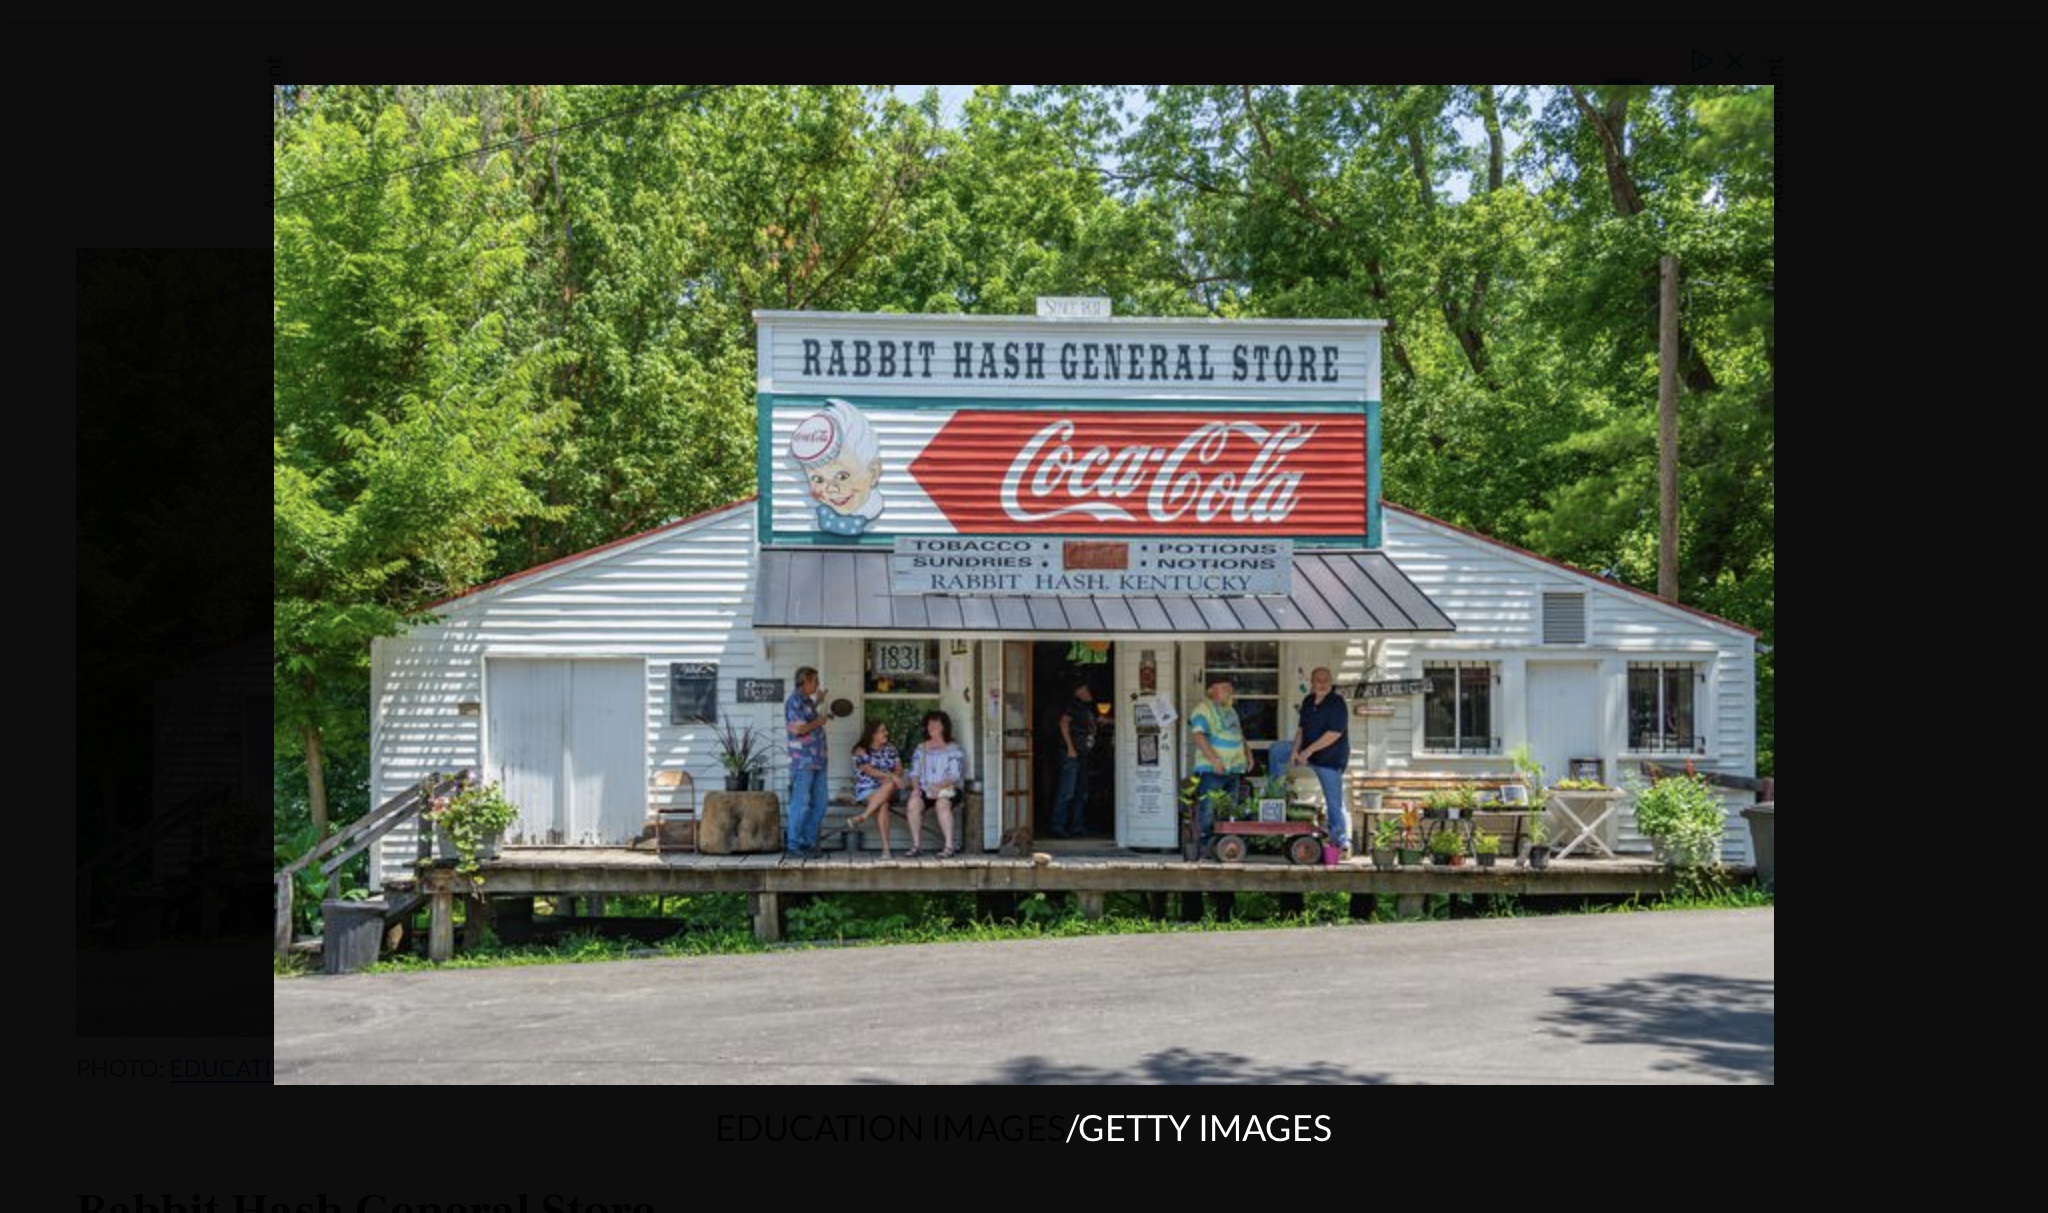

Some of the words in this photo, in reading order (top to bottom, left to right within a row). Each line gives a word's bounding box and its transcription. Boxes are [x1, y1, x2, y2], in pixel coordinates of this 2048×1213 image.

[802, 338, 935, 378] RABBIT
[953, 341, 1046, 380] HASH
[1060, 342, 1215, 380] GENERAL
[1232, 344, 1339, 383] STORE
[1000, 418, 1320, 523] Coca-Cola
[912, 540, 1032, 552] TOBACCO
[1158, 543, 1277, 554] POTIONS
[913, 556, 1032, 568] SUNDRIES
[1157, 558, 1276, 570] NOTIONS
[930, 574, 1022, 590] RABBIT
[1119, 574, 1252, 591] KENTUCKY
[880, 644, 920, 671] 1831
